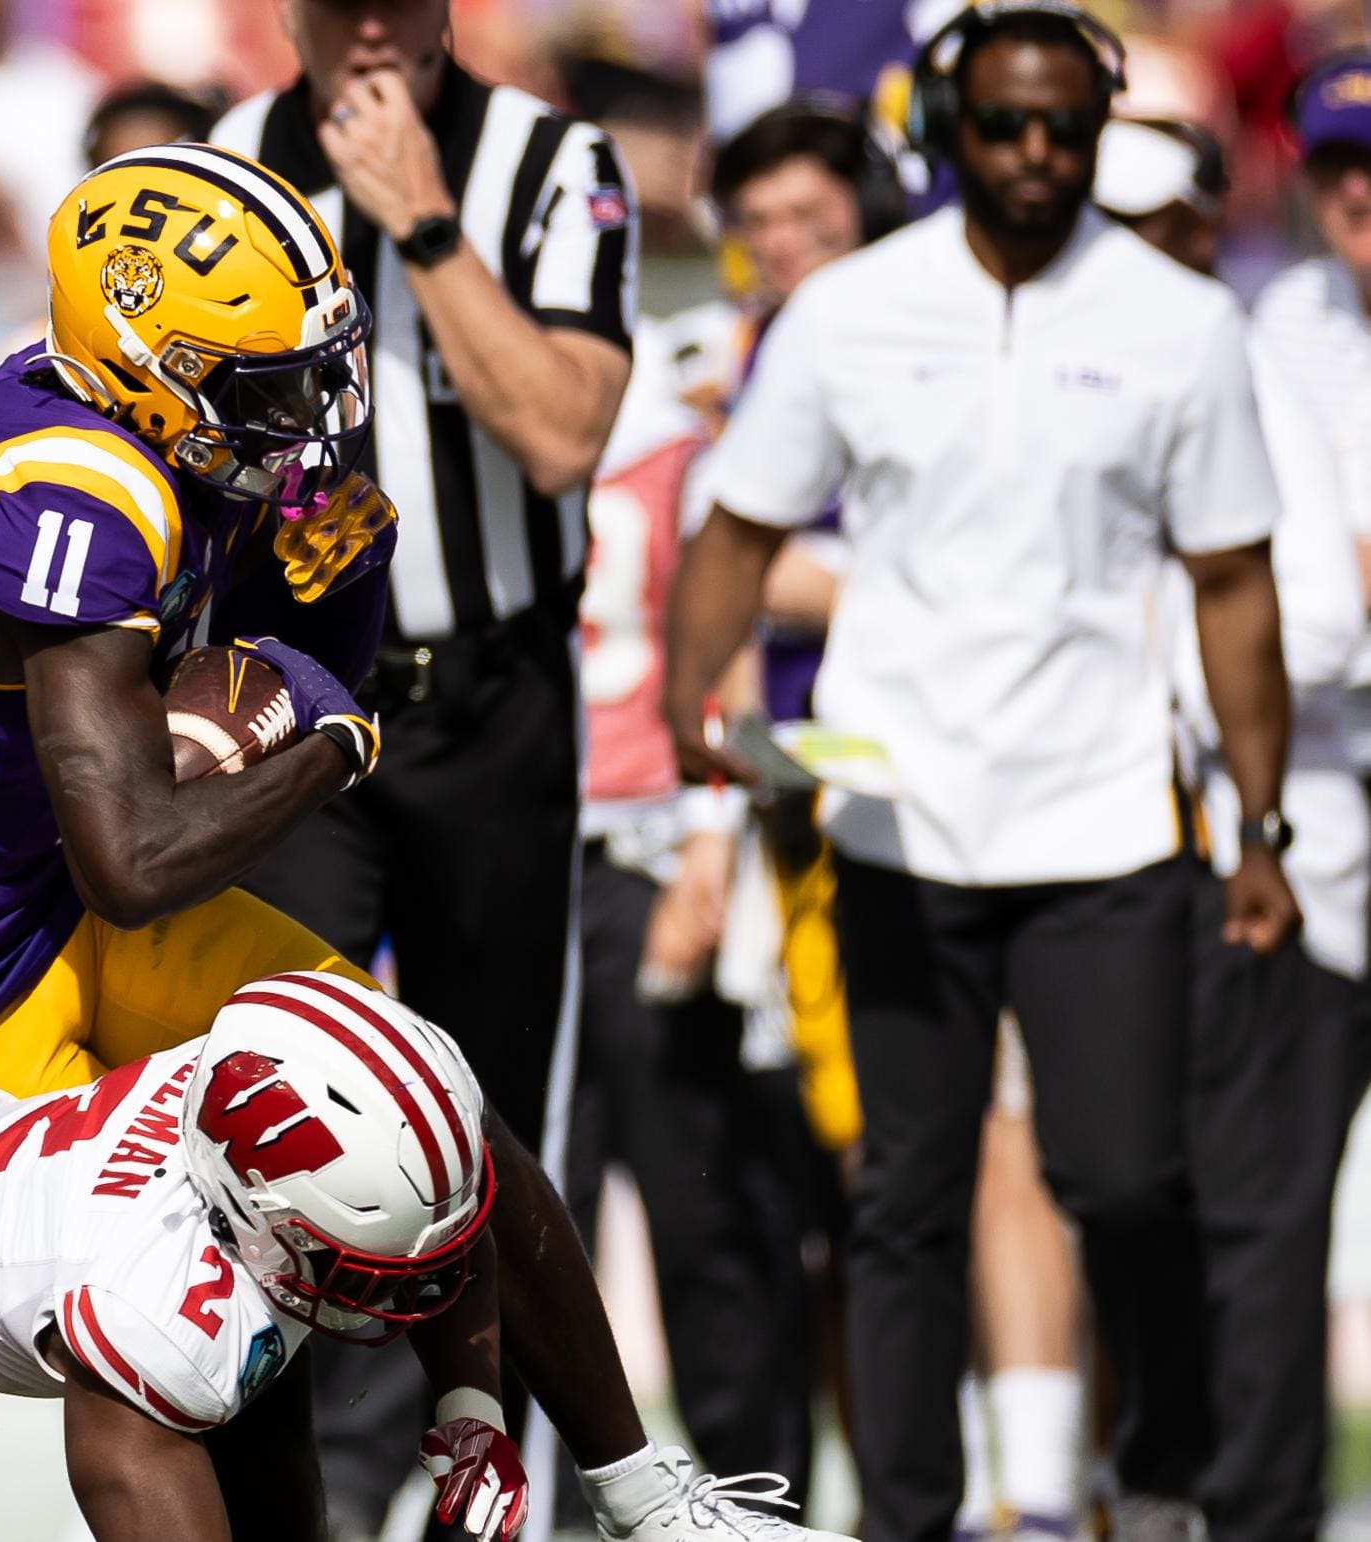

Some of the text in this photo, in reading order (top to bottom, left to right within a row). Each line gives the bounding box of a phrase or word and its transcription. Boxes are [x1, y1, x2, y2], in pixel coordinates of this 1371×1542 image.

[77, 188, 240, 277] LSU
[20, 509, 95, 618] 11
[177, 1244, 235, 1341] 2
